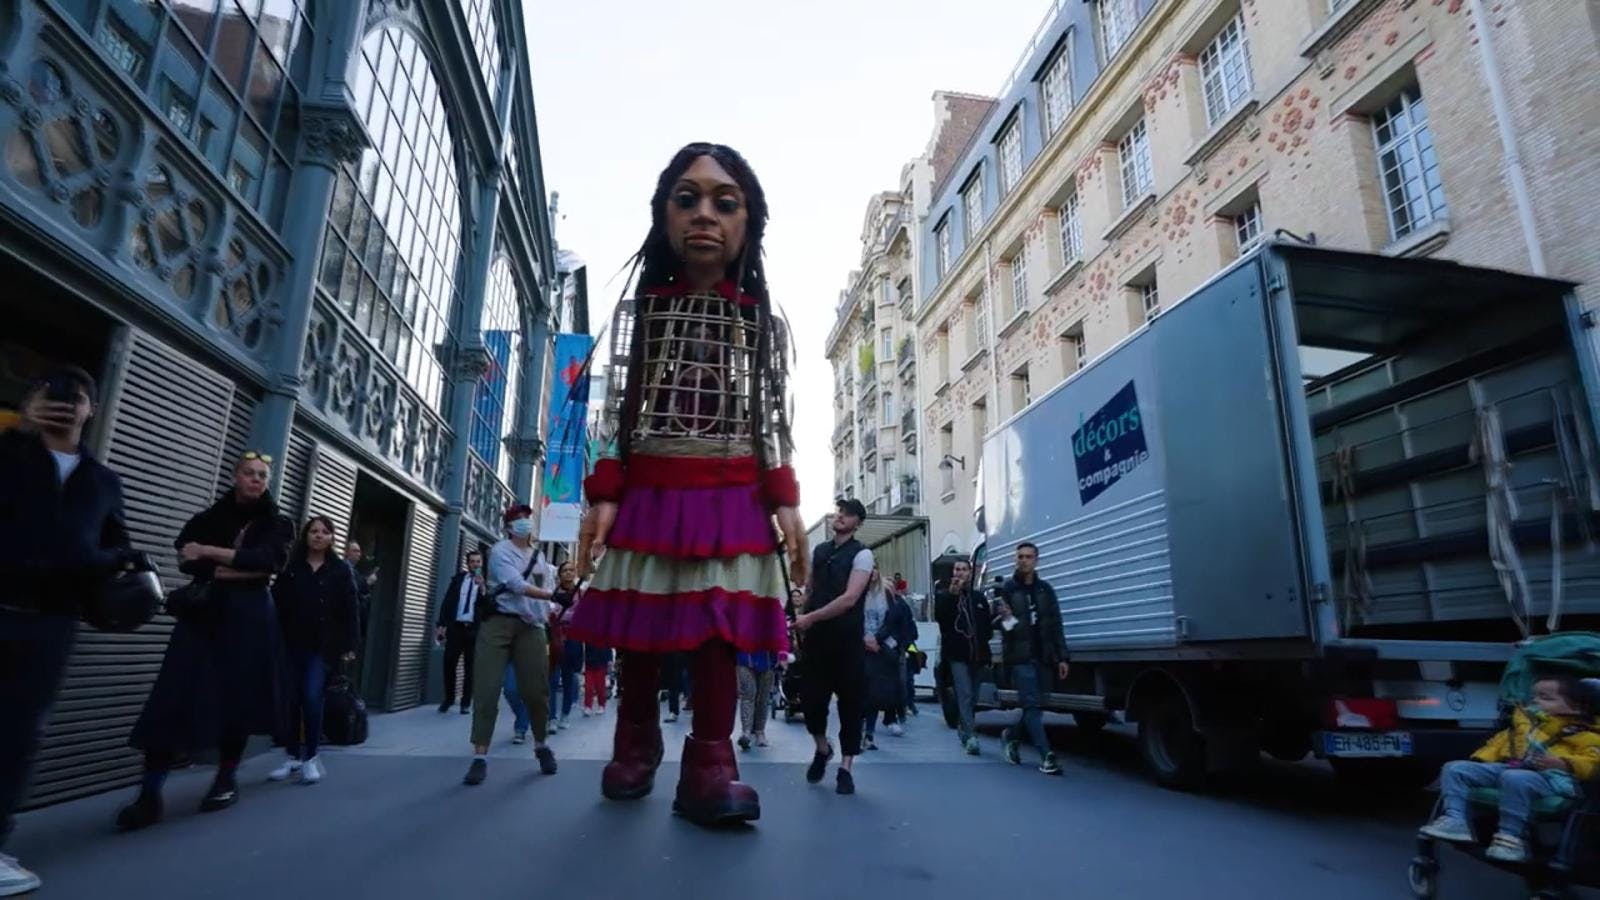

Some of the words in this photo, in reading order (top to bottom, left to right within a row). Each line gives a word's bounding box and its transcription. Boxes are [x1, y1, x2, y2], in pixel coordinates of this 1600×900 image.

[1074, 404, 1140, 458] décors
[1079, 449, 1149, 490] compagnie
[1104, 448, 1112, 461] &
